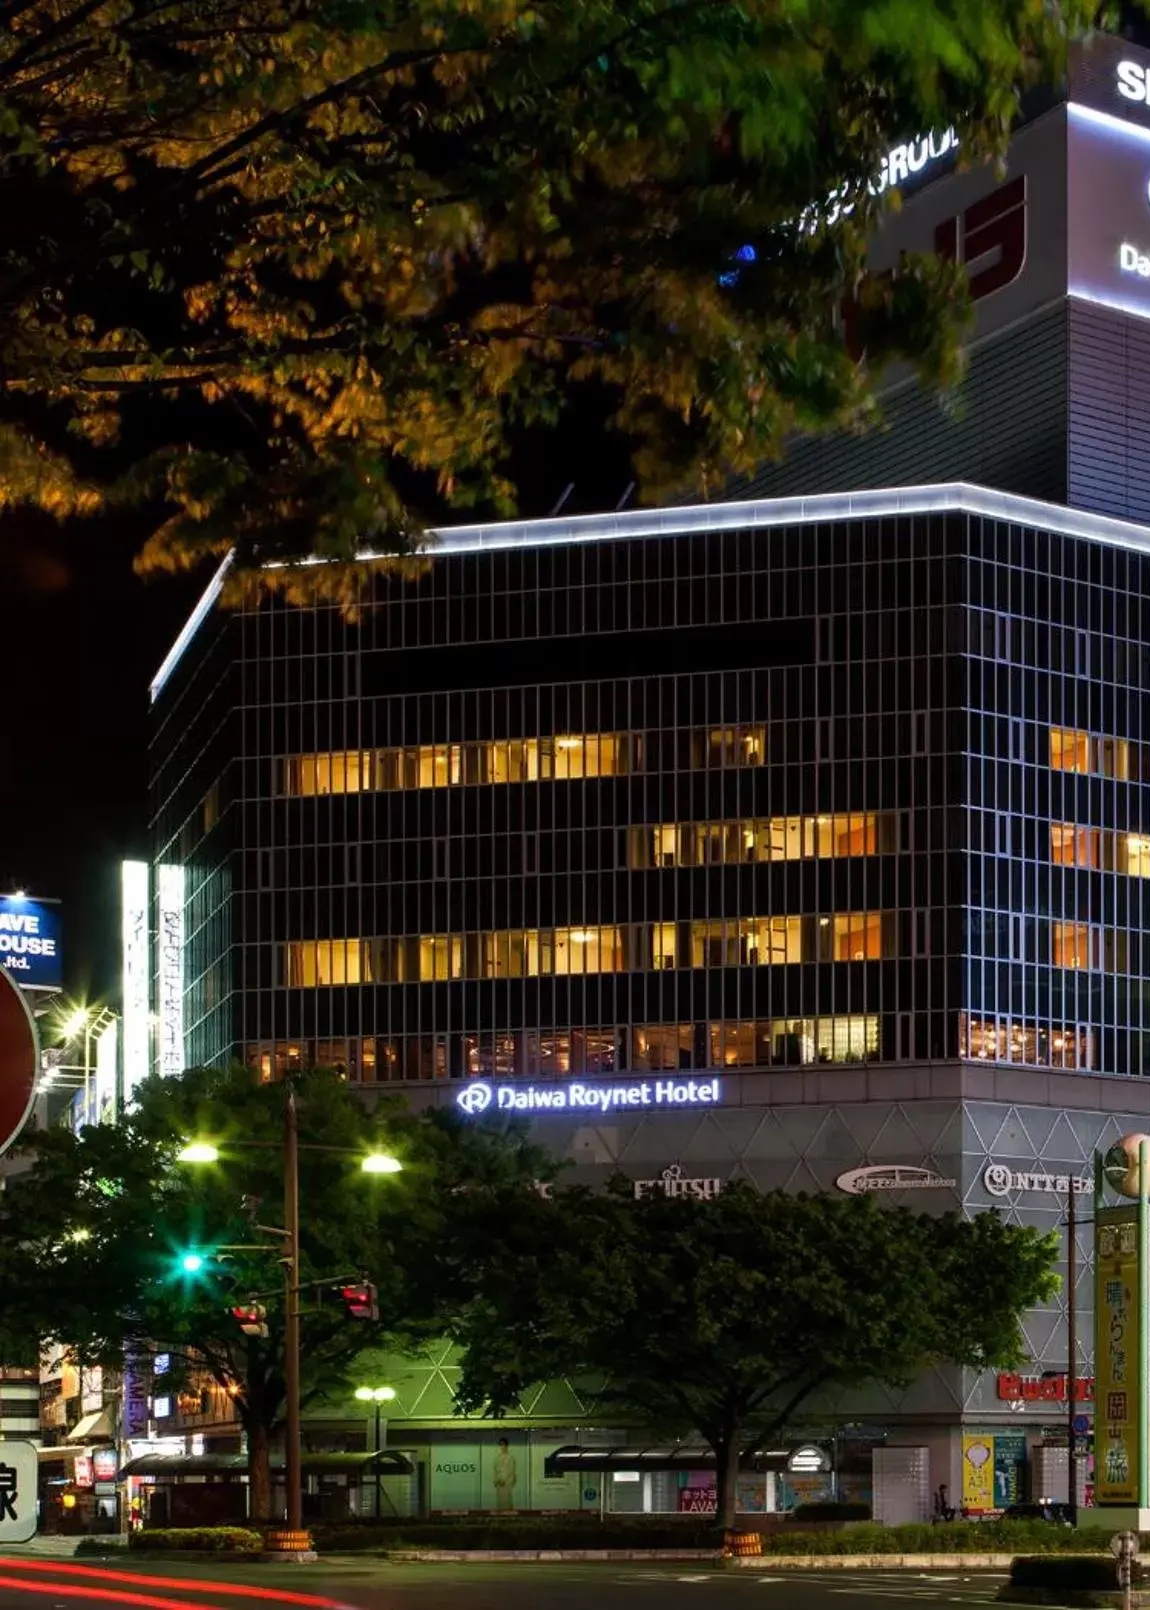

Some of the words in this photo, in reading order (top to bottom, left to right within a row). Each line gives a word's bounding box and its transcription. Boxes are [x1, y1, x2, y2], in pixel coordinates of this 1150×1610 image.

[867, 124, 960, 196] GROU
[498, 1087, 565, 1109] Daiwa
[569, 1082, 650, 1112] Roynet
[655, 1078, 719, 1102] Hotel
[435, 1463, 477, 1474] AQUOS
